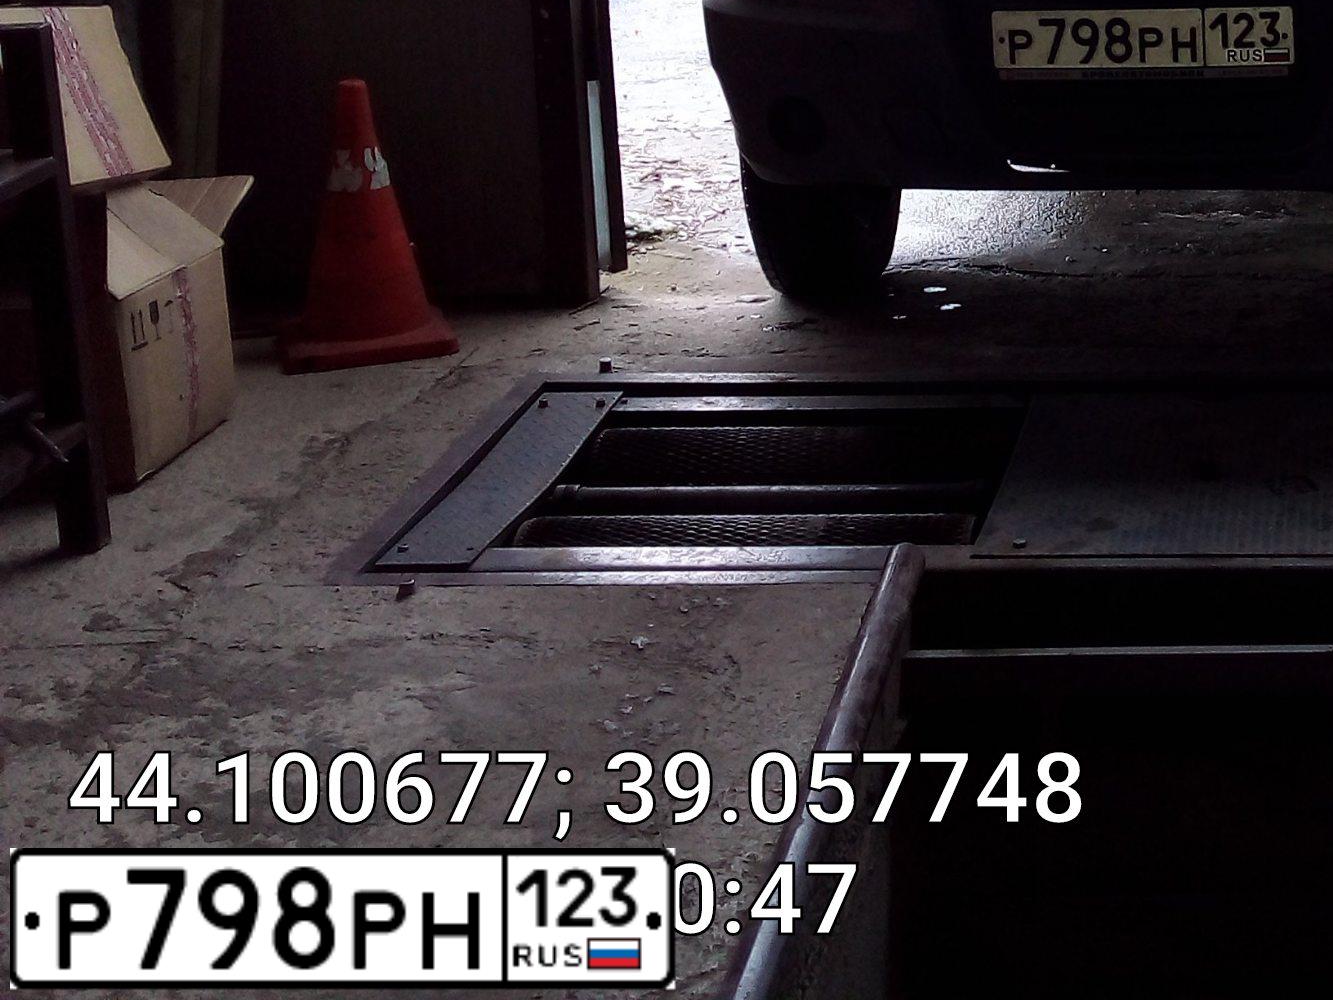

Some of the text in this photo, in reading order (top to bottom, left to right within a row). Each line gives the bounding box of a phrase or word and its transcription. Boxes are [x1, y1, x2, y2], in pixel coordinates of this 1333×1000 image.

[1007, 10, 1281, 66] Р798РН 123
[1227, 48, 1264, 64] RUS
